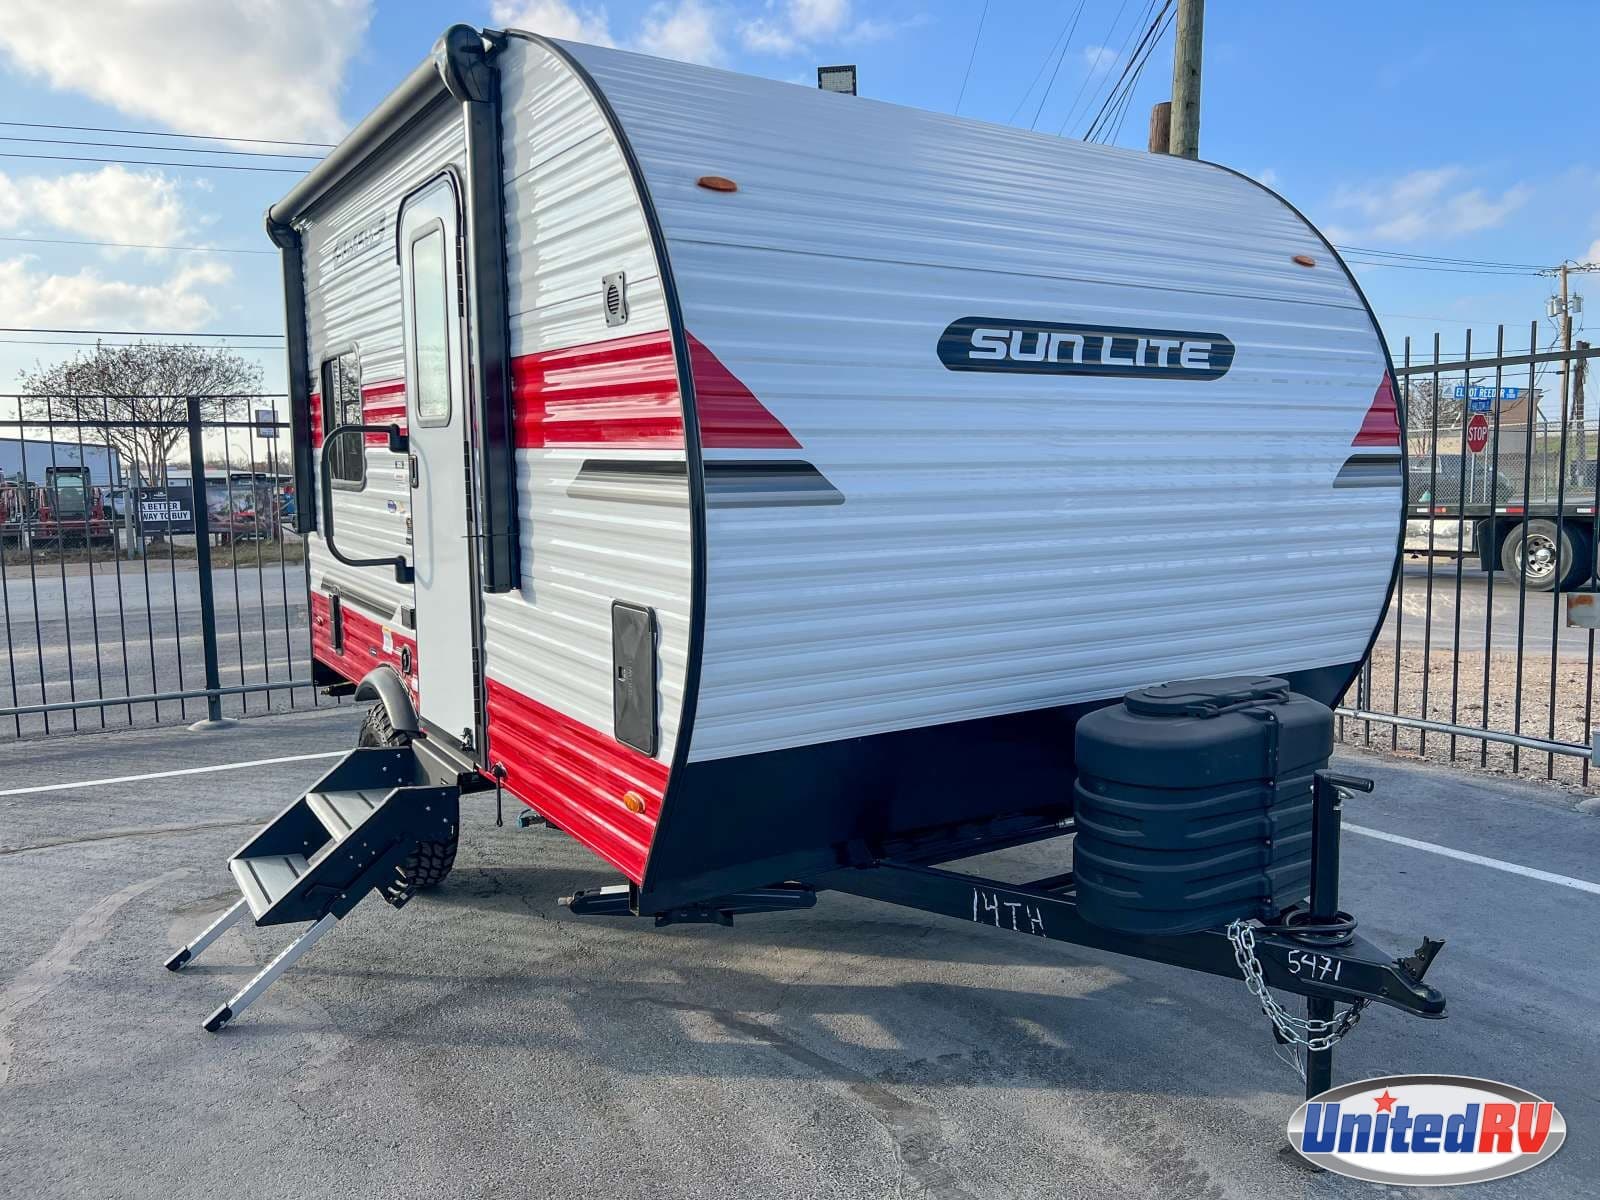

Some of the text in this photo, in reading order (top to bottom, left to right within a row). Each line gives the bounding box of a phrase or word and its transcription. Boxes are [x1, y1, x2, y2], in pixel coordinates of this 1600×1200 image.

[969, 328, 1212, 370] SUN LITE
[1468, 426, 1488, 441] STOP
[172, 512, 188, 520] BUY
[1288, 949, 1342, 981] 5471
